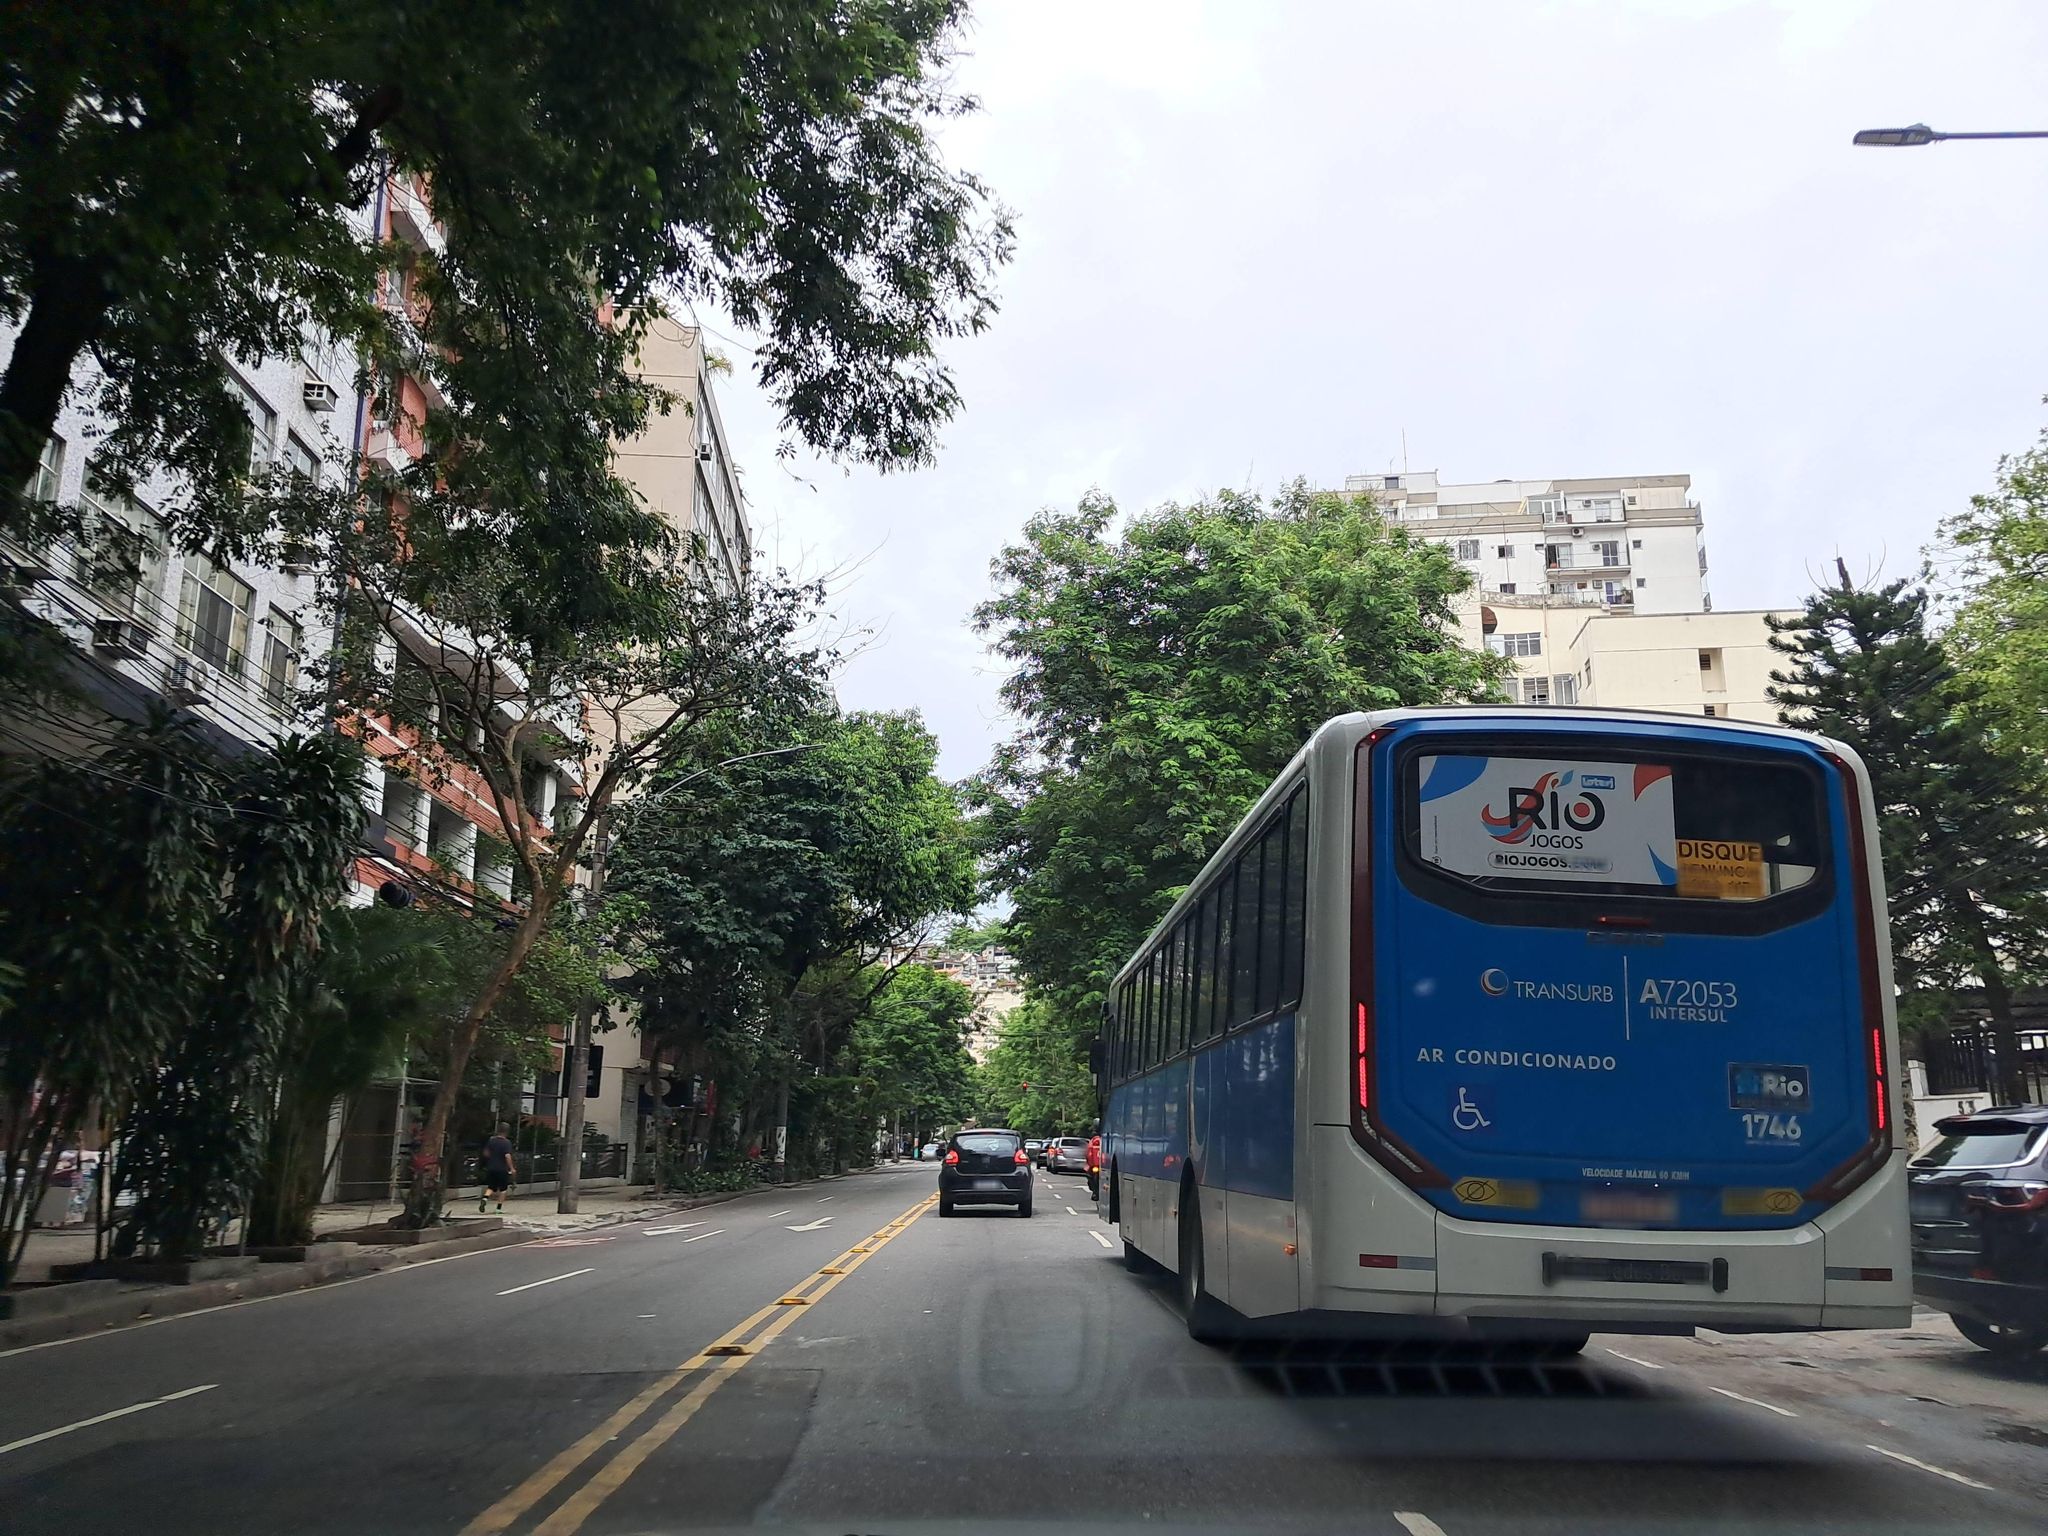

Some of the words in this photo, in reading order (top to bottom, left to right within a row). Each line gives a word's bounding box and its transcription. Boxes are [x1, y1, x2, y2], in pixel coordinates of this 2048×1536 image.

[1508, 786, 1606, 832] RIO
[1530, 834, 1584, 850] JOGOS
[1678, 841, 1761, 862] DISQUE
[1513, 980, 1615, 1003] TRANSURB
[1639, 978, 1738, 1009] A72053
[1650, 1006, 1728, 1023] INTERSUL
[1416, 1047, 1445, 1063] AR
[1454, 1049, 1617, 1071] CONDICIONADO
[1762, 1073, 1804, 1097] Rio
[1742, 1113, 1802, 1140] 1746
[1581, 1167, 1624, 1179] VELOCIDADE
